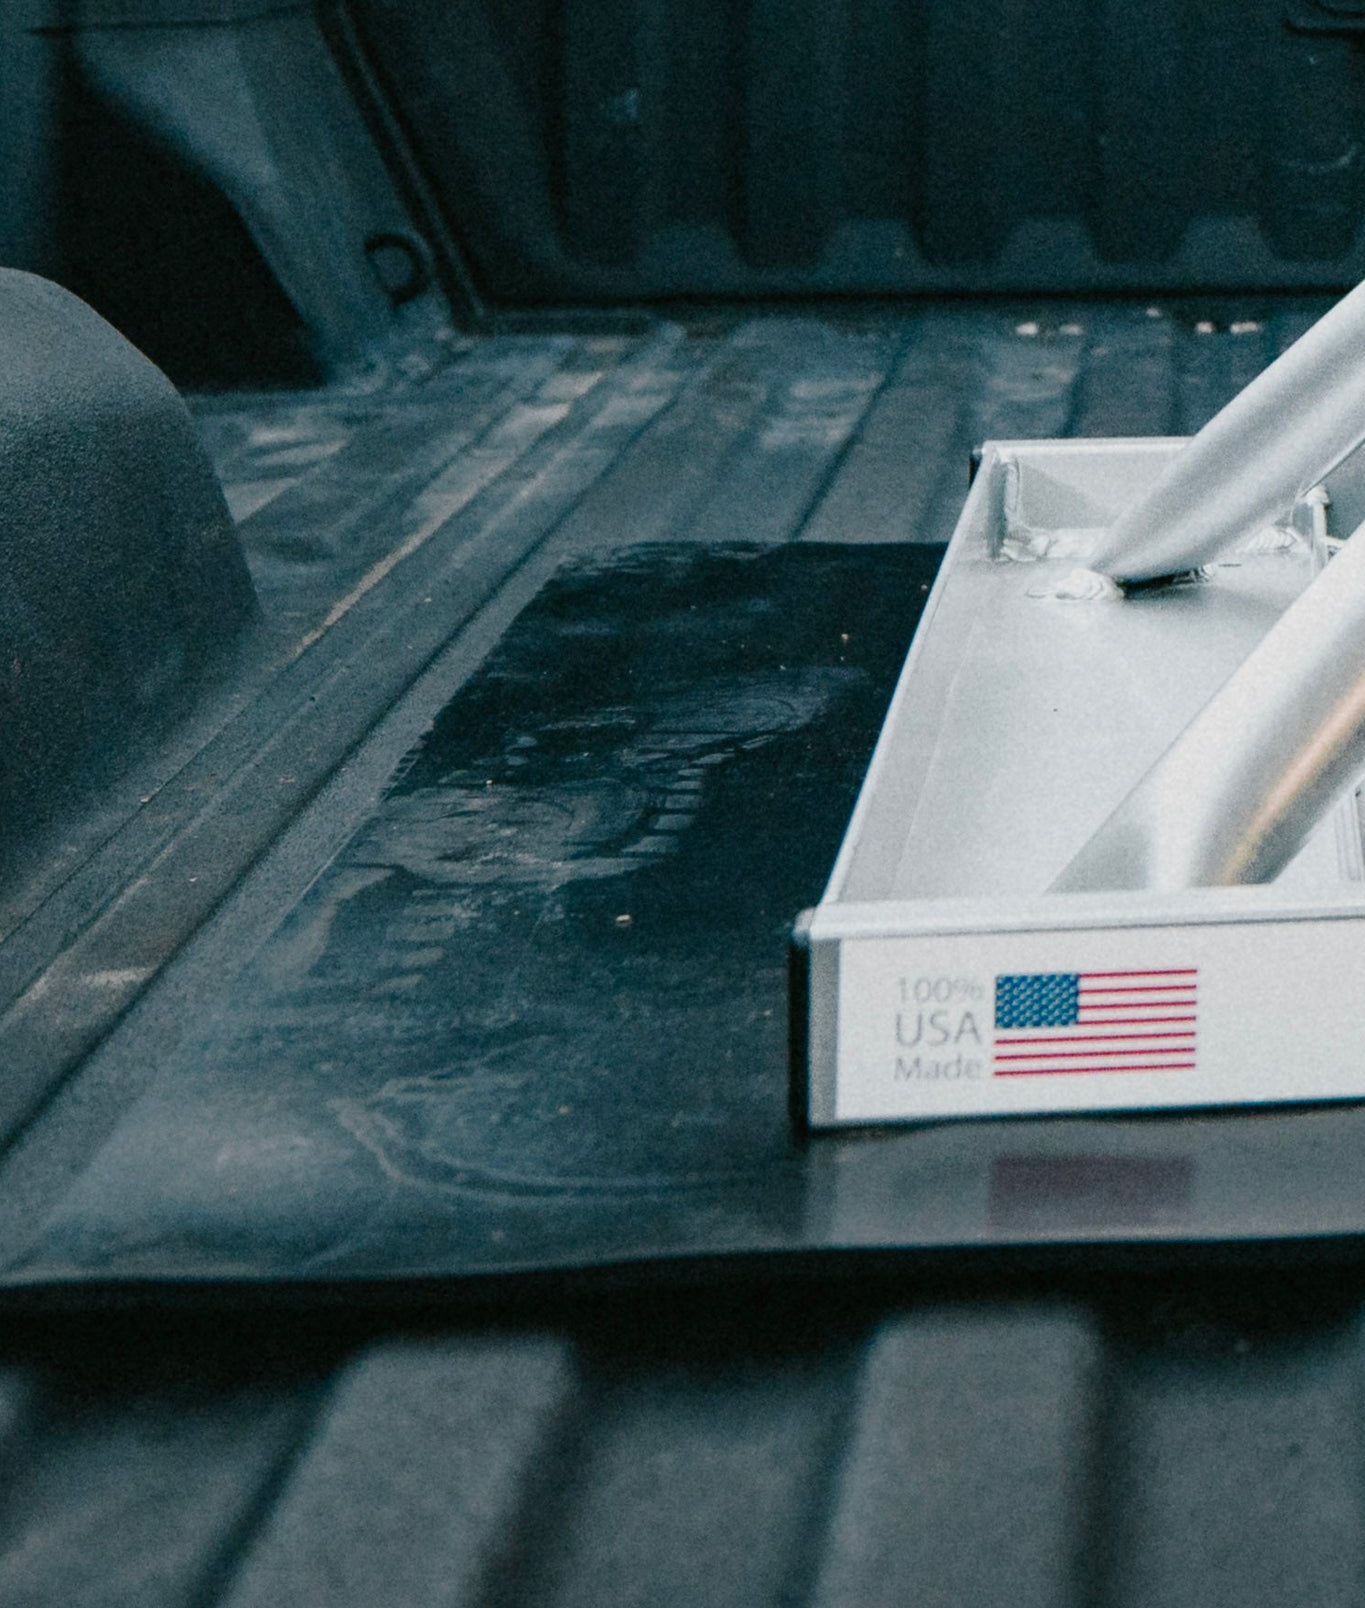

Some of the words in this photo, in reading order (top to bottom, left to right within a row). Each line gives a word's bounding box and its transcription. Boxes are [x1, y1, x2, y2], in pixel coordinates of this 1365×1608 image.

[899, 976, 983, 1004] 100%
[894, 1009, 982, 1048] USA
[894, 1054, 981, 1081] Made
